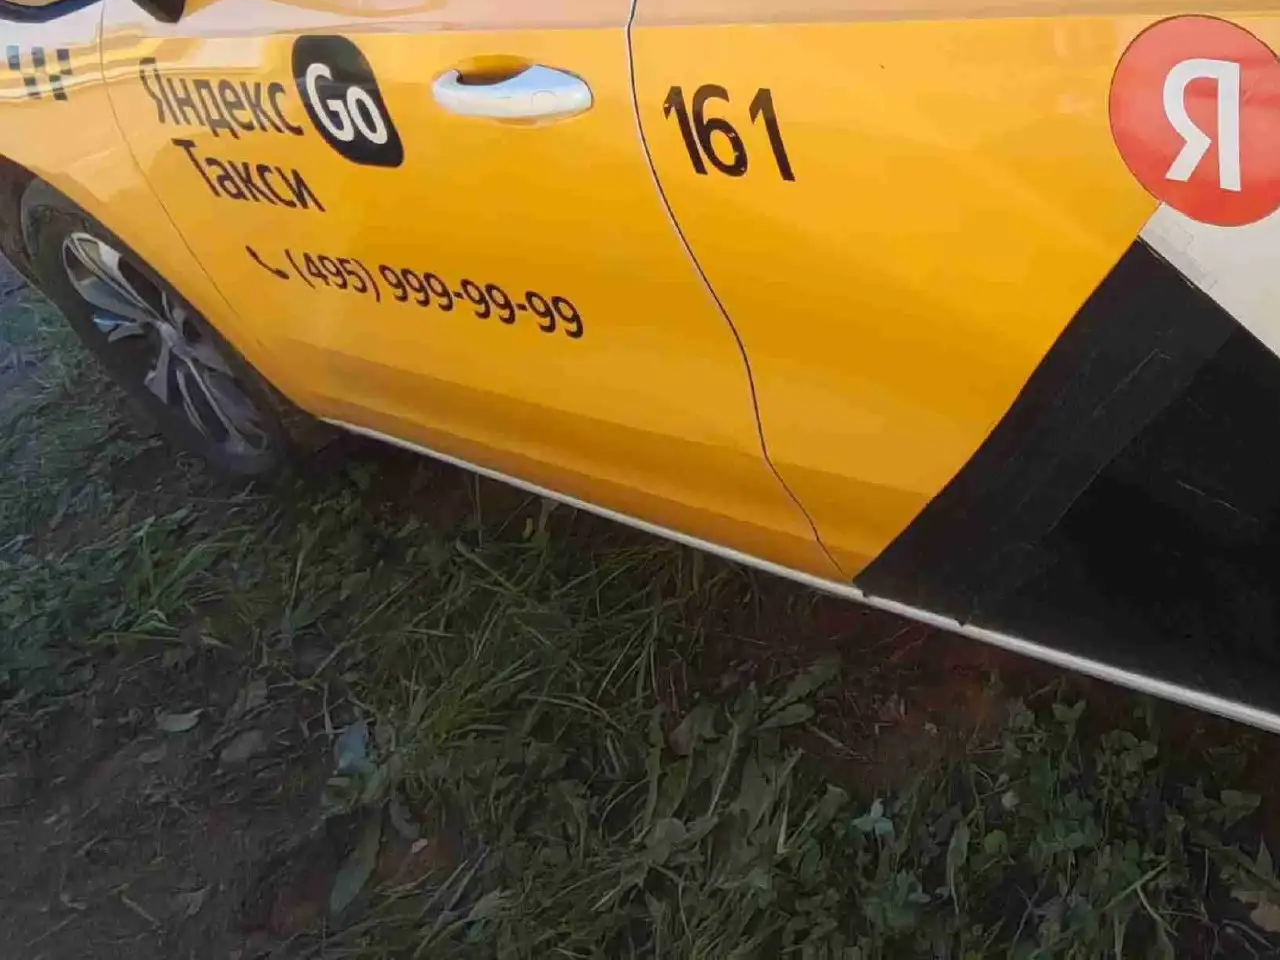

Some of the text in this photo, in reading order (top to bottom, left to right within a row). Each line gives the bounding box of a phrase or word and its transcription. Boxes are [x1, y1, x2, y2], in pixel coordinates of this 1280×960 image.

[139, 56, 388, 145] Яндекс Go
[663, 84, 796, 182] 161
[1163, 58, 1241, 192] Я
[171, 138, 326, 213] Такси
[285, 248, 584, 339] (495) 999-99-99
